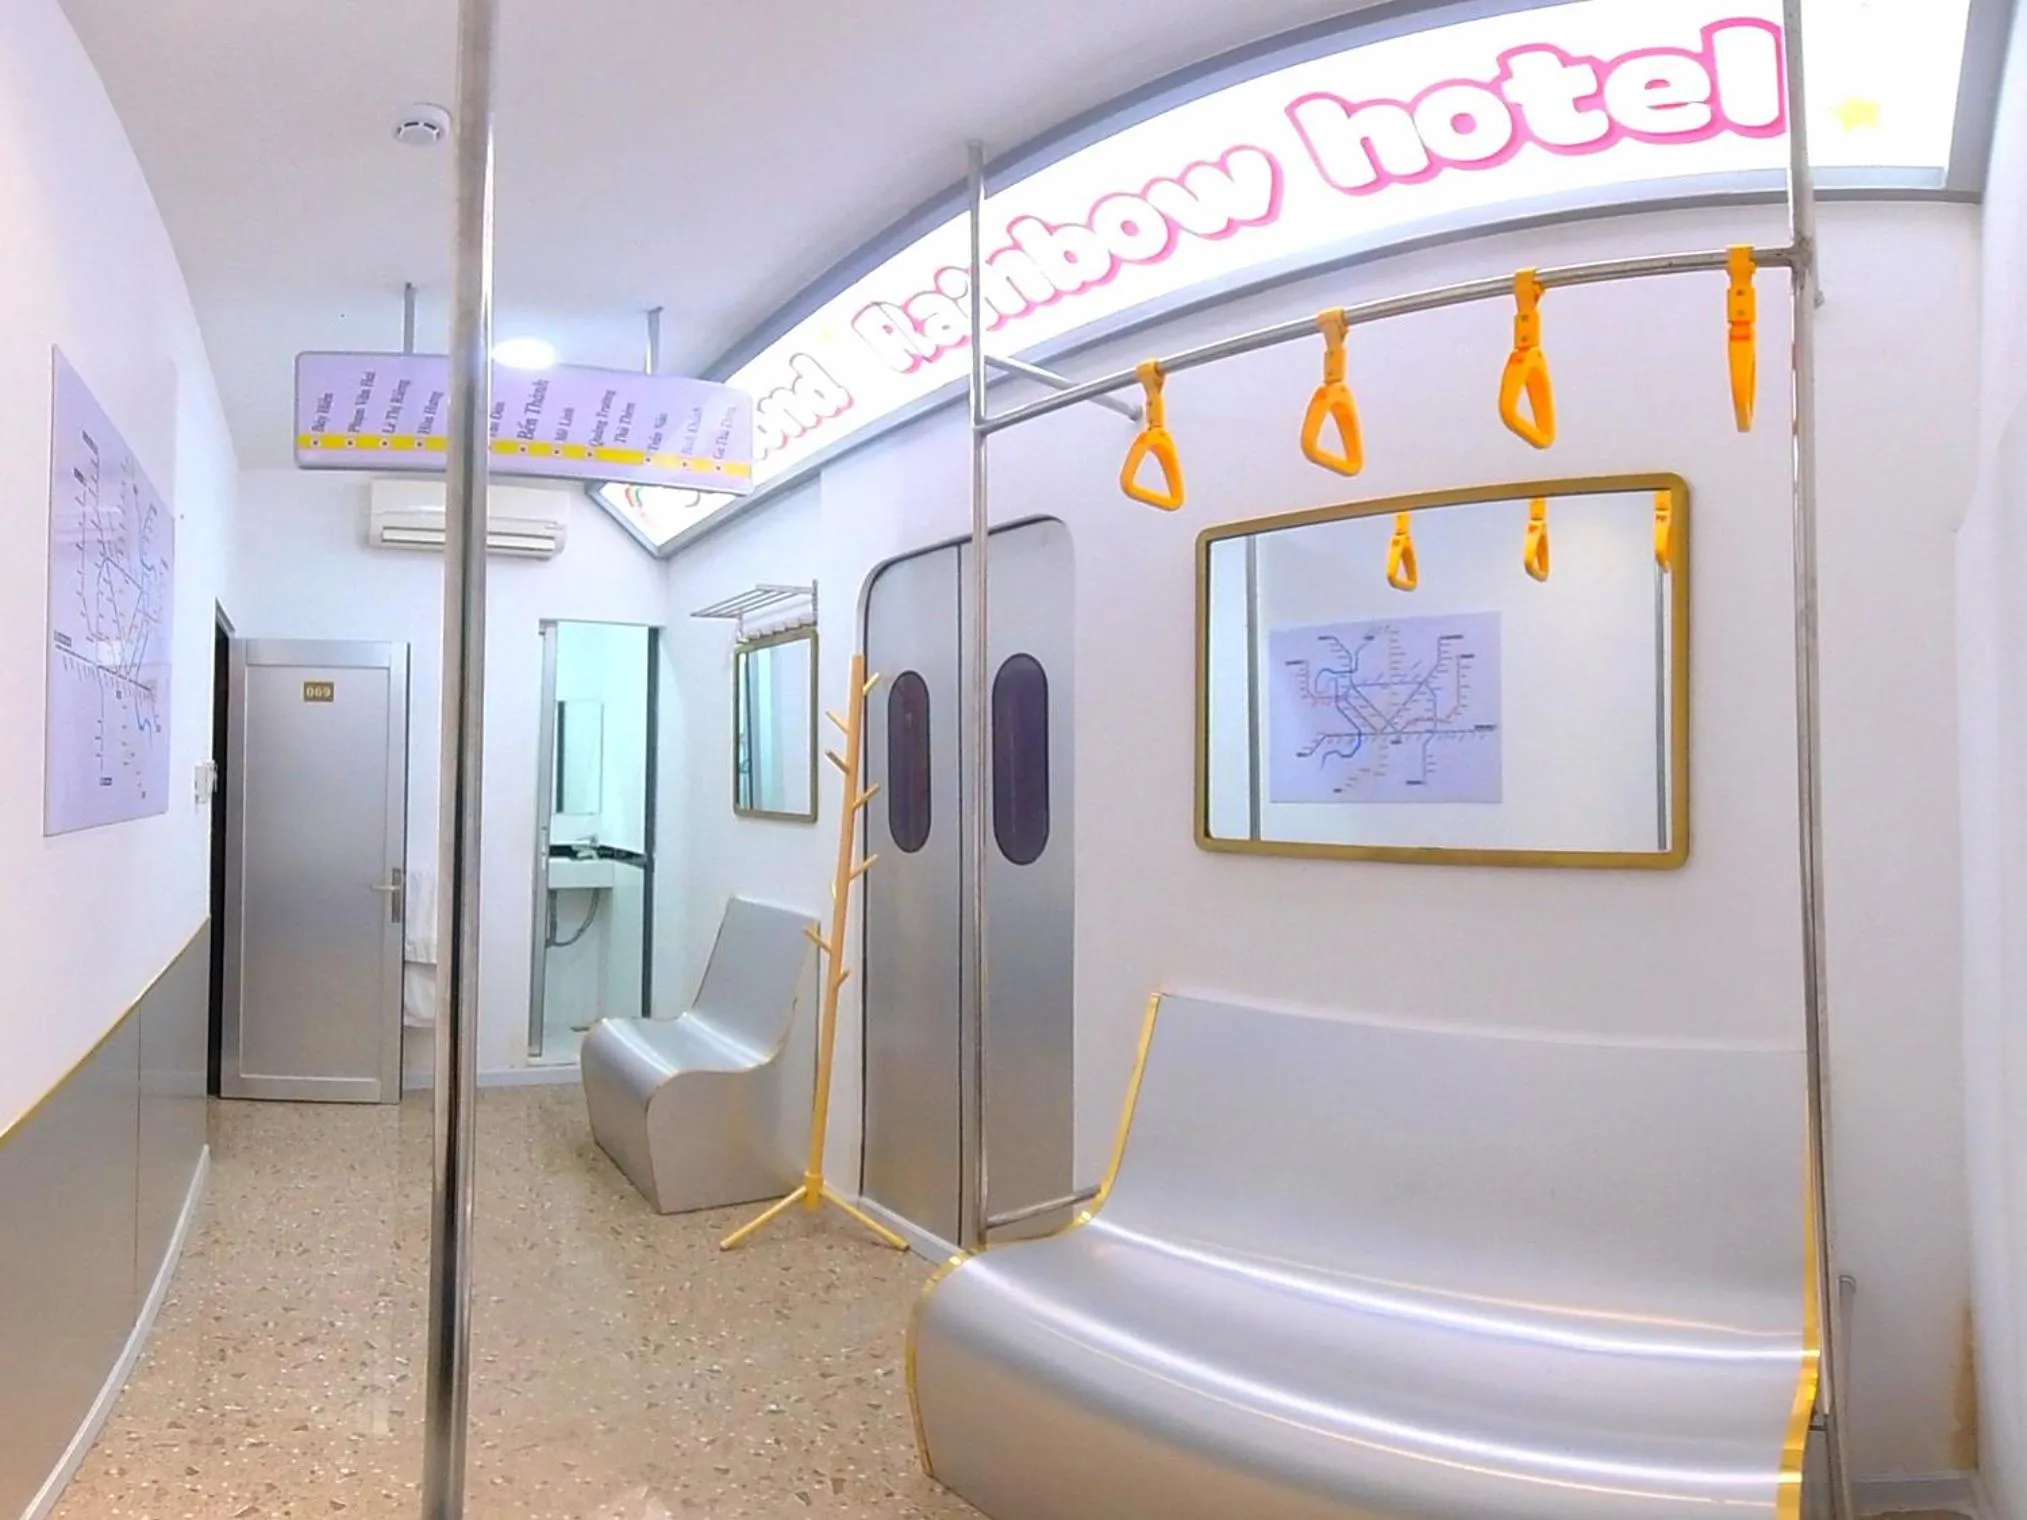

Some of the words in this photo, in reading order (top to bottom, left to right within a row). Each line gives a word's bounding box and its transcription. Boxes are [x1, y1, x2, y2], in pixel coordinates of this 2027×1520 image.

[755, 352, 854, 461] and
[850, 144, 1284, 374] Rainbow
[1284, 17, 1787, 197] hotel
[524, 378, 549, 414] Thành
[516, 418, 539, 440] Bến
